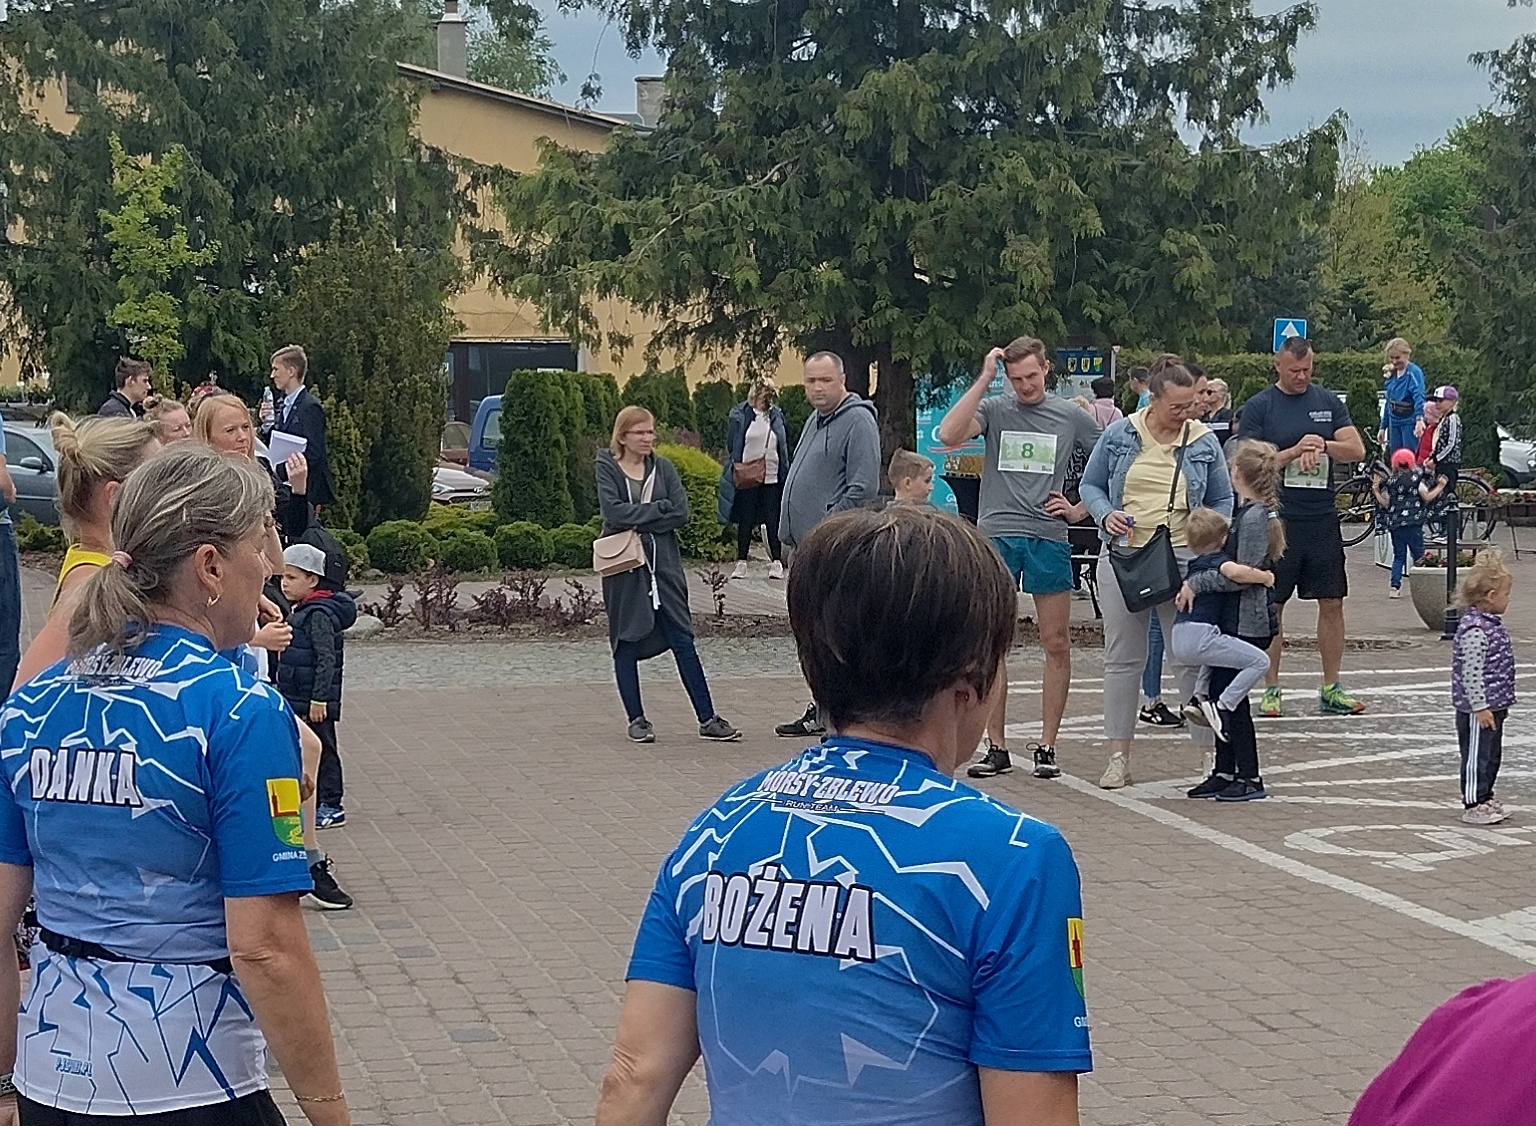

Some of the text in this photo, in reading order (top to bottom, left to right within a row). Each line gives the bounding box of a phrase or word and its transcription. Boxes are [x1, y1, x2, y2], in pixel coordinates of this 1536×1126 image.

[1021, 442, 1034, 459] 8
[30, 748, 142, 806] DANKA
[757, 770, 900, 804] MORSY-ZBLEWO
[703, 865, 873, 960] BOŻENA
